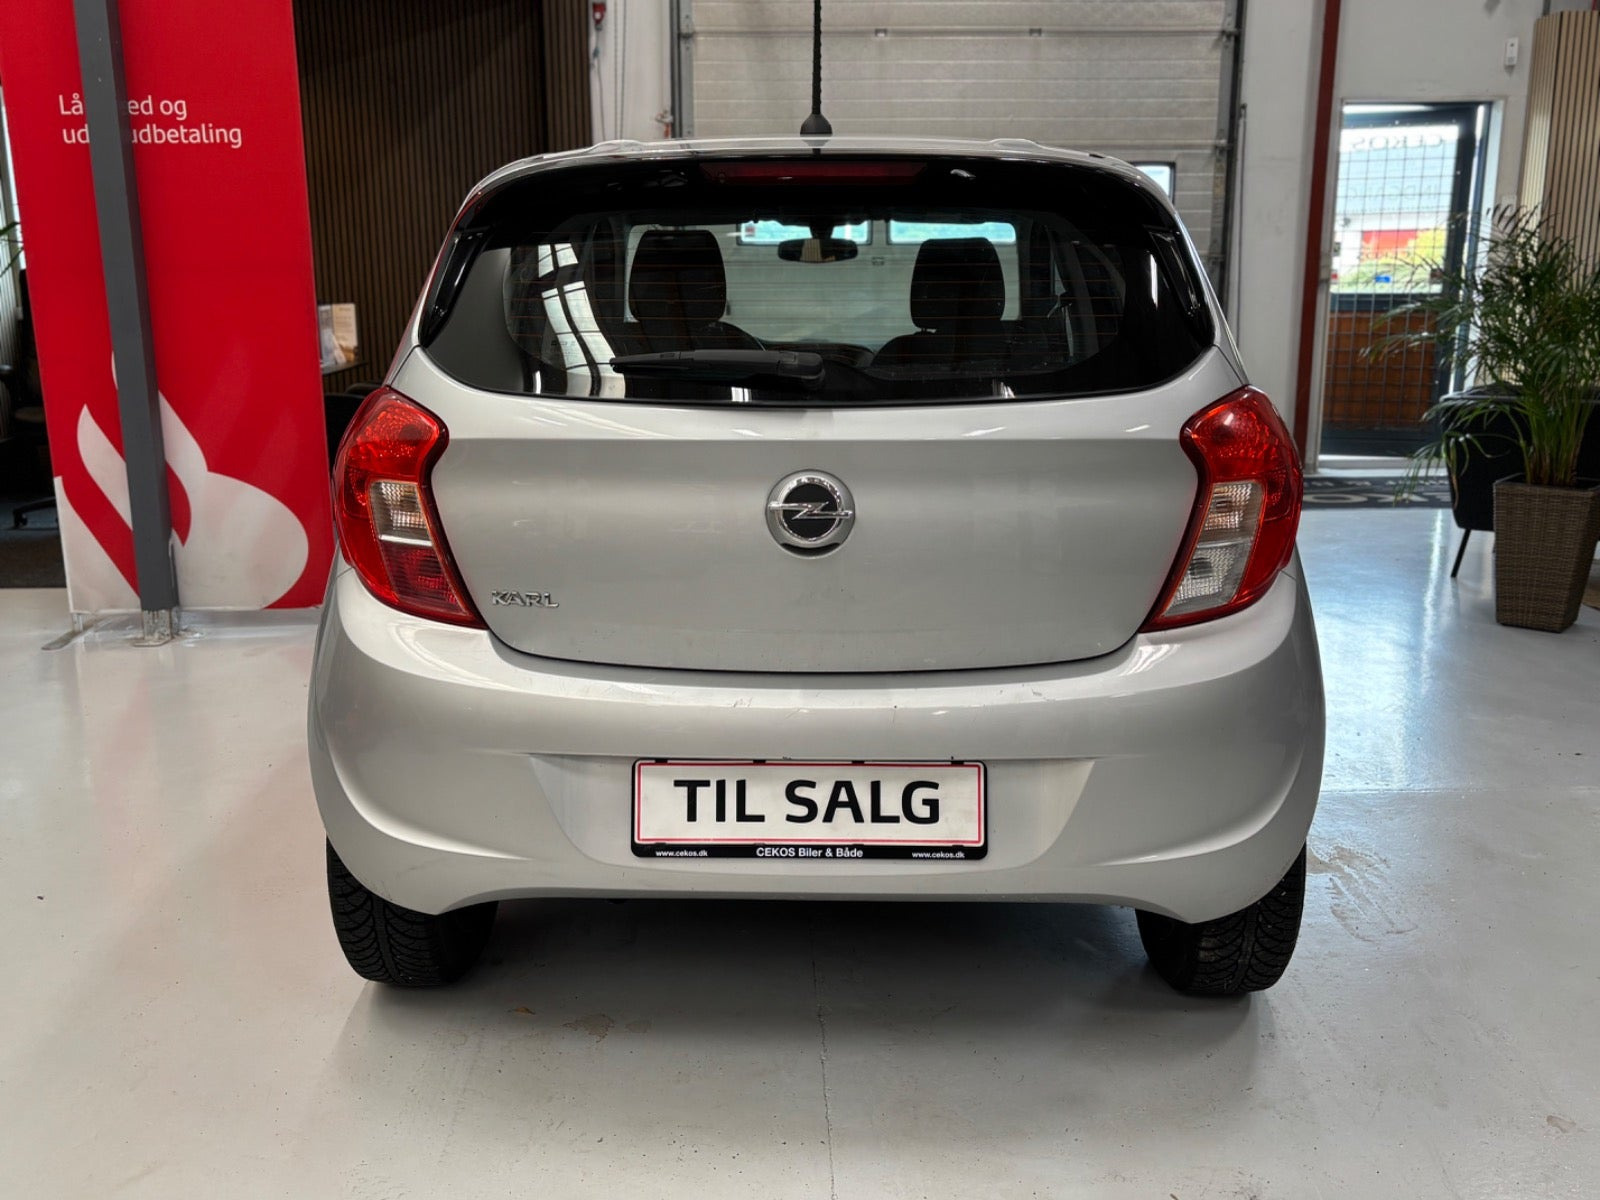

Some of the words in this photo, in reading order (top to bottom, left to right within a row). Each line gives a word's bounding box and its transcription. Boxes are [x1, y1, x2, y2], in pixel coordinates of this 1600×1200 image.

[127, 95, 154, 115] ed
[159, 99, 188, 121] og
[491, 590, 560, 608] KARL
[673, 779, 765, 823] TIL
[785, 779, 940, 825] SALG
[655, 849, 708, 857] www.cekos.dk
[756, 847, 796, 857] CEKOS
[798, 847, 823, 857] Biler
[825, 847, 833, 857] &
[836, 847, 864, 858] Både
[911, 851, 966, 859] www.cekos.dk
